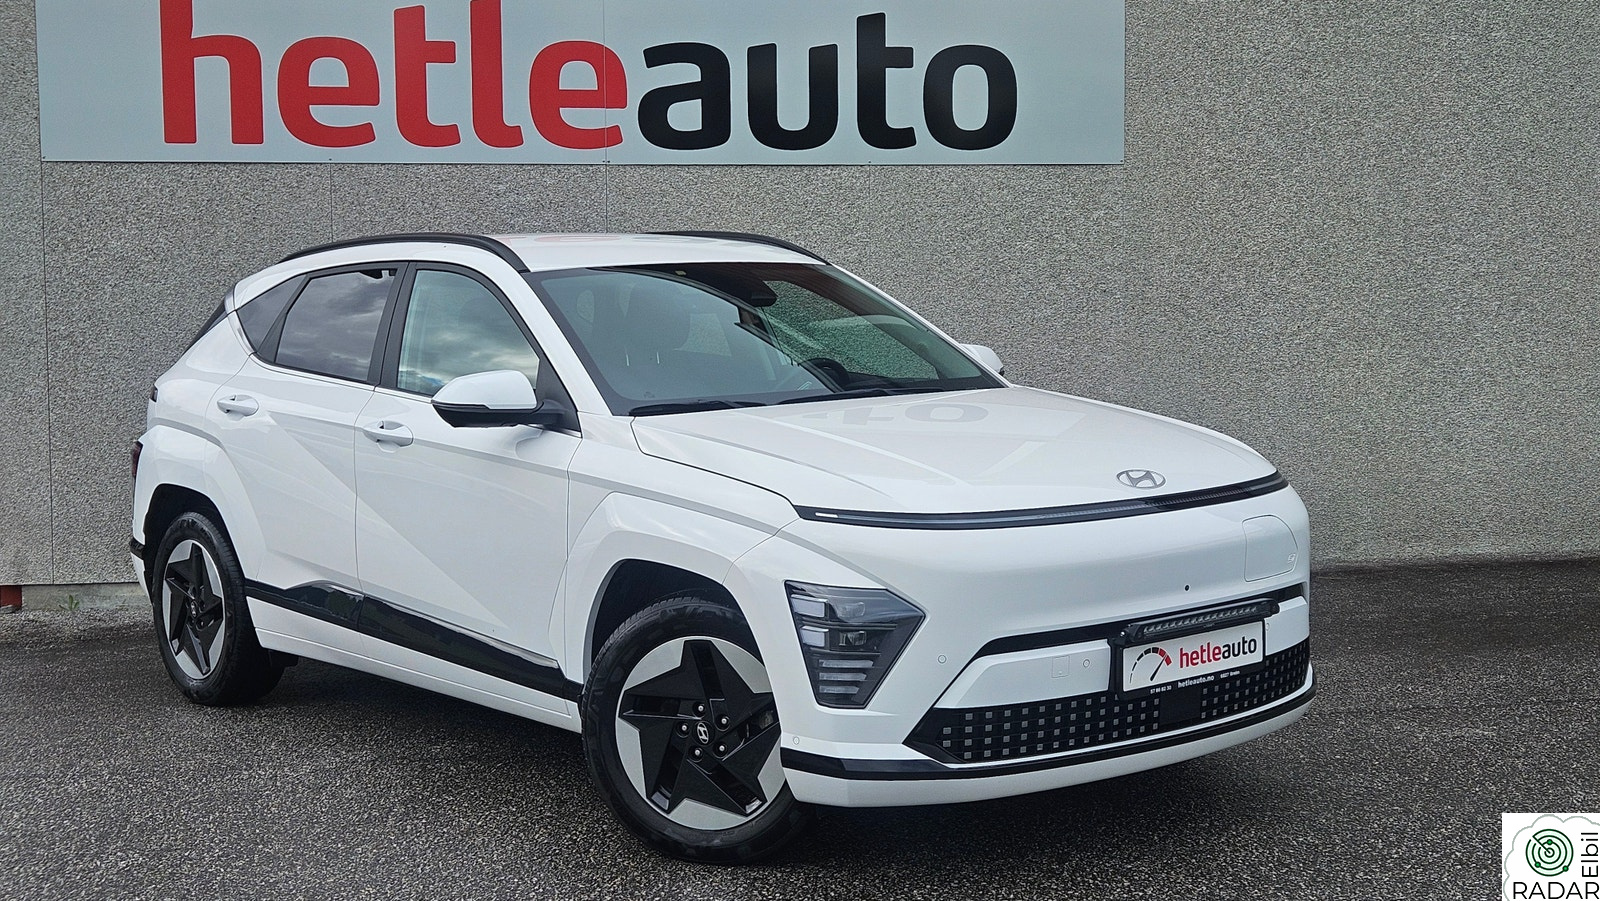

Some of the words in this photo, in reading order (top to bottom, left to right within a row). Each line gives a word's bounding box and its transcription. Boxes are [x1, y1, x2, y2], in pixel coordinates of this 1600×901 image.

[160, 0, 1018, 150] hetleauto
[1179, 636, 1257, 668] hetleauto
[1178, 675, 1215, 688] hetleauto.no
